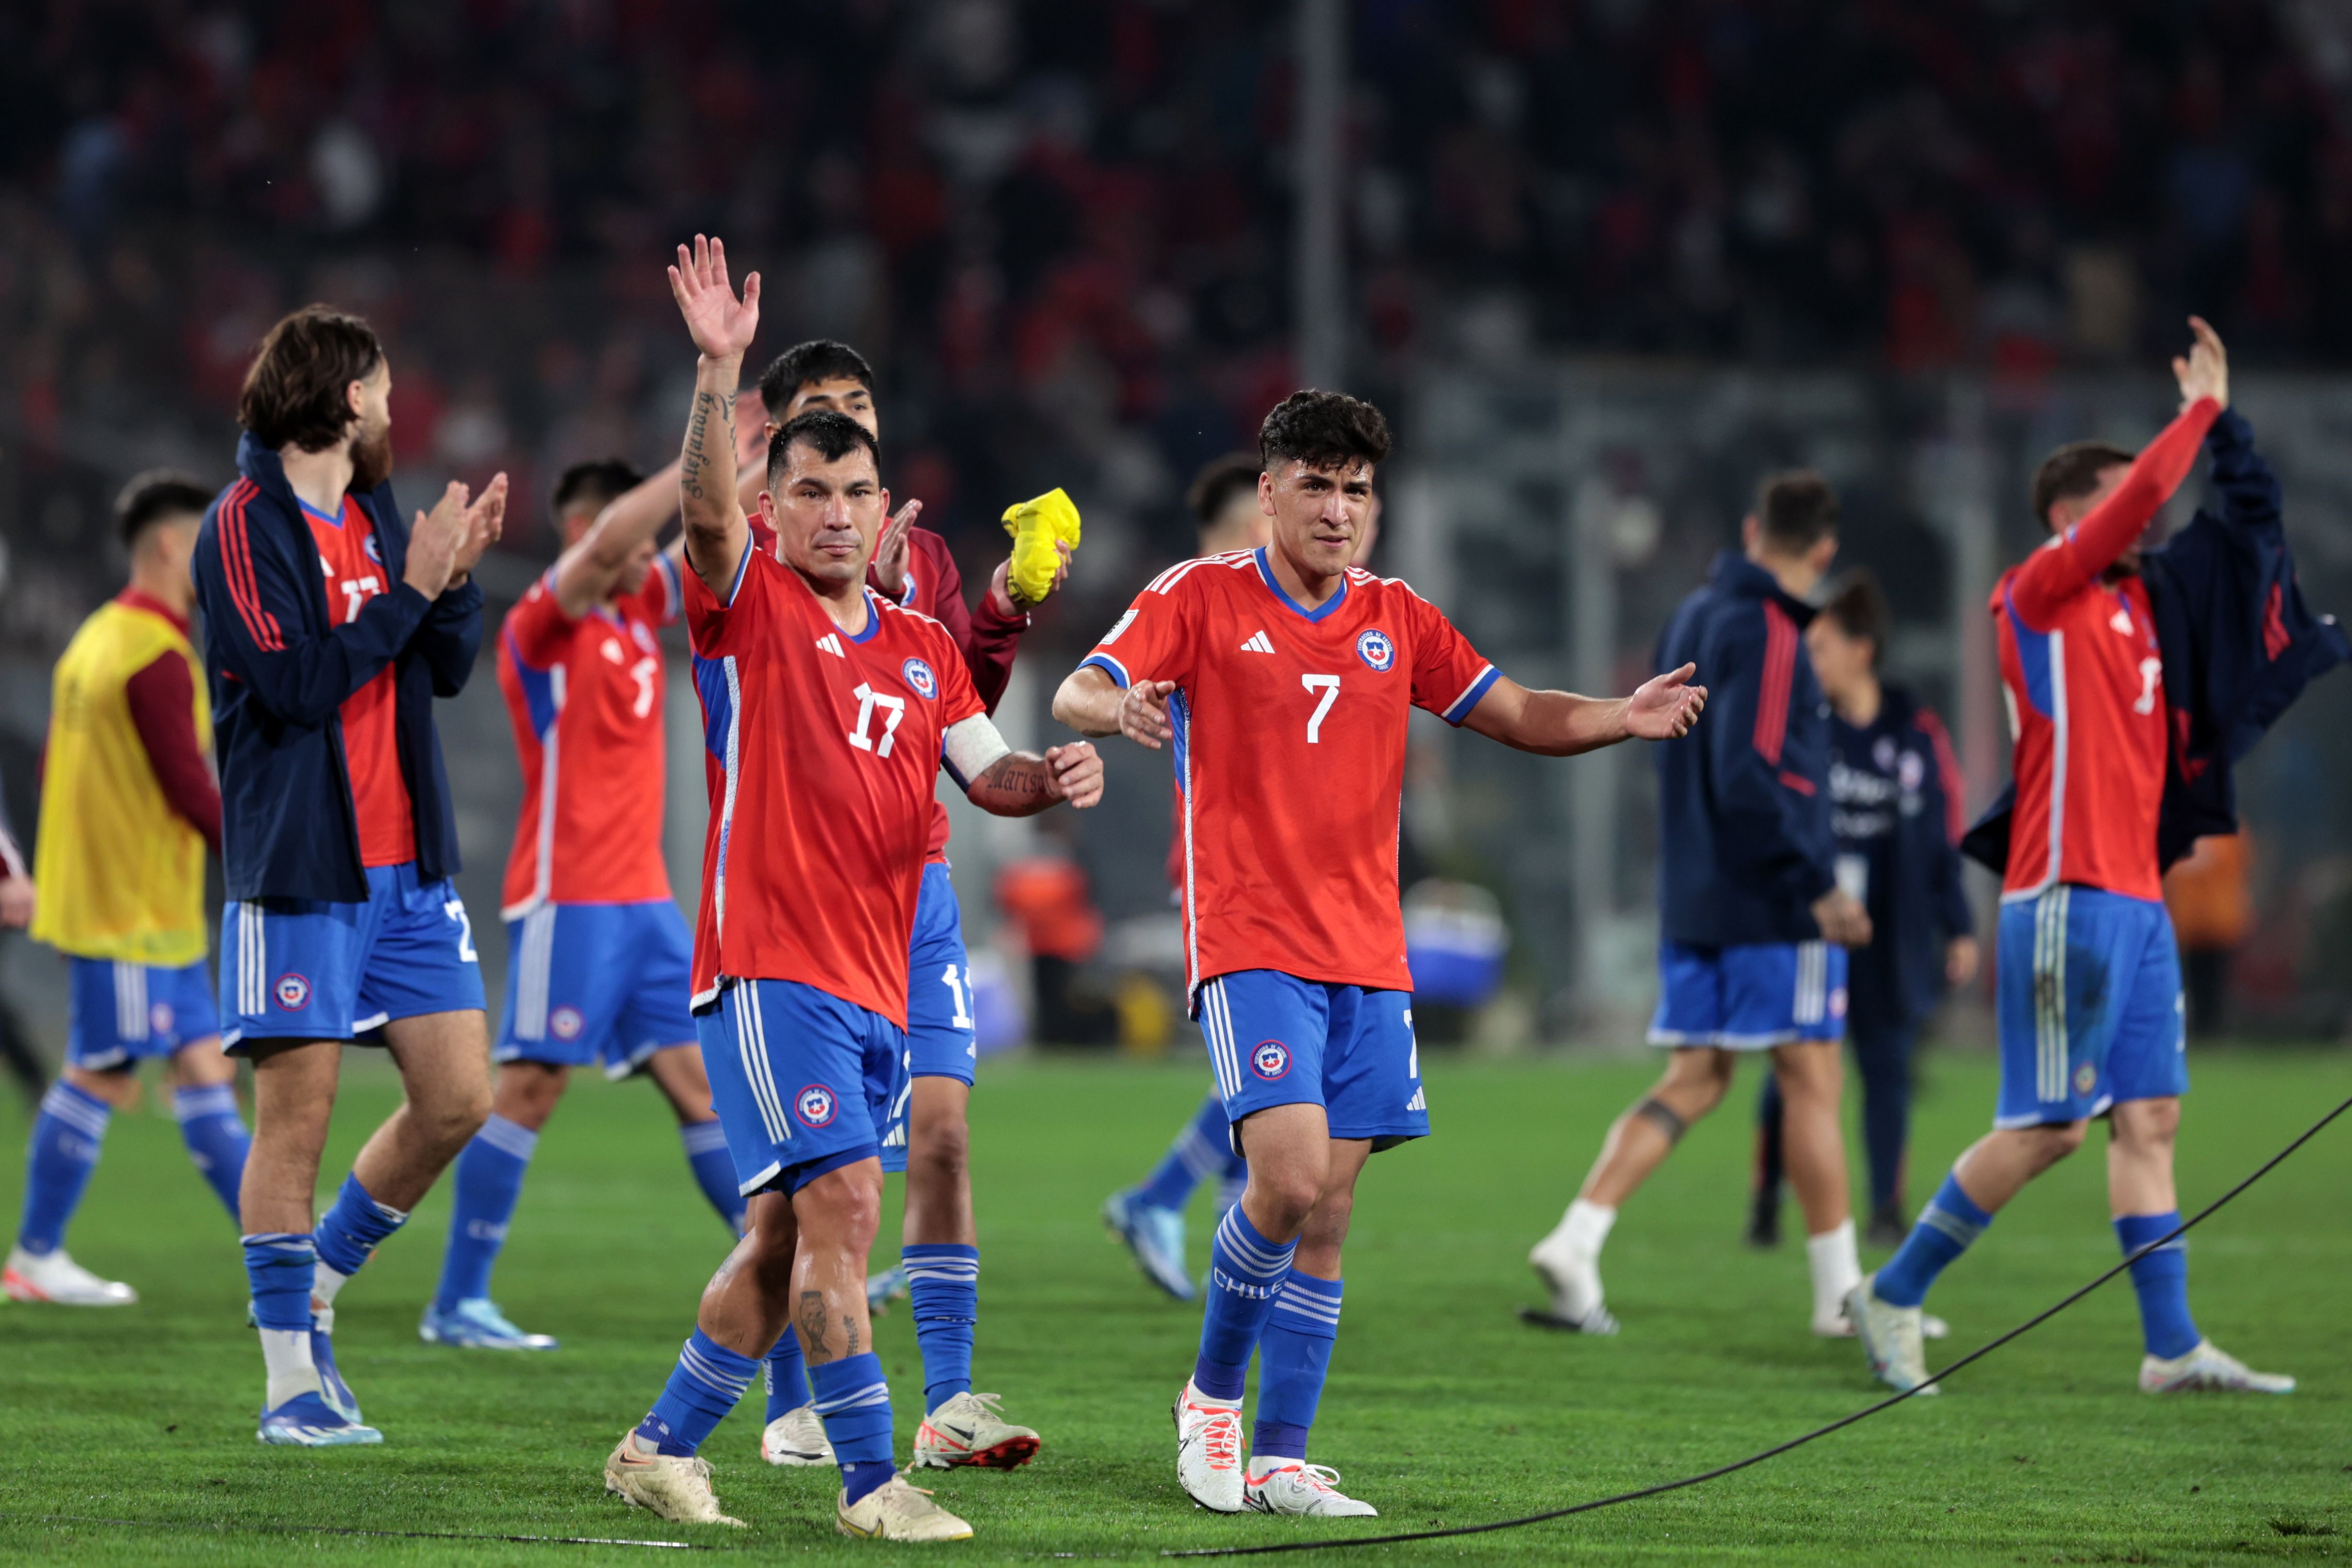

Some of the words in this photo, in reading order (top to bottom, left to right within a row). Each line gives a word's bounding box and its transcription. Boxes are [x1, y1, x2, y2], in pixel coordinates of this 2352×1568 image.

[849, 681, 905, 758] 17
[1301, 674, 1340, 743] 7
[1215, 1267, 1286, 1300] CHILE
